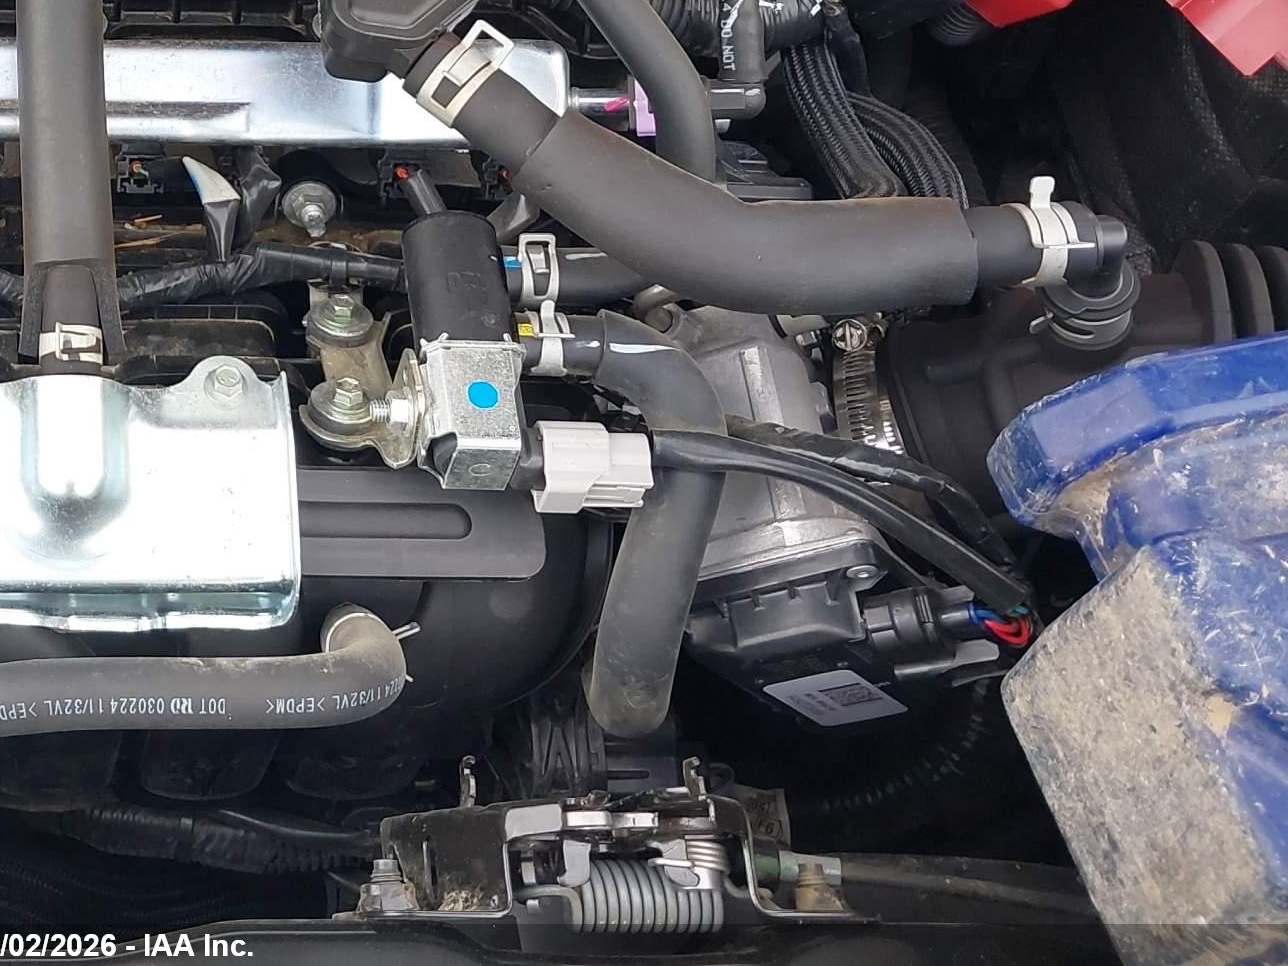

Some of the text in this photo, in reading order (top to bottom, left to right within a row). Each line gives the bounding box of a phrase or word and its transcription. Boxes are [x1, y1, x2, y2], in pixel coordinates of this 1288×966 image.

[723, 46, 736, 71] NOT
[110, 697, 165, 715] 030224
[200, 698, 226, 715] DOT
